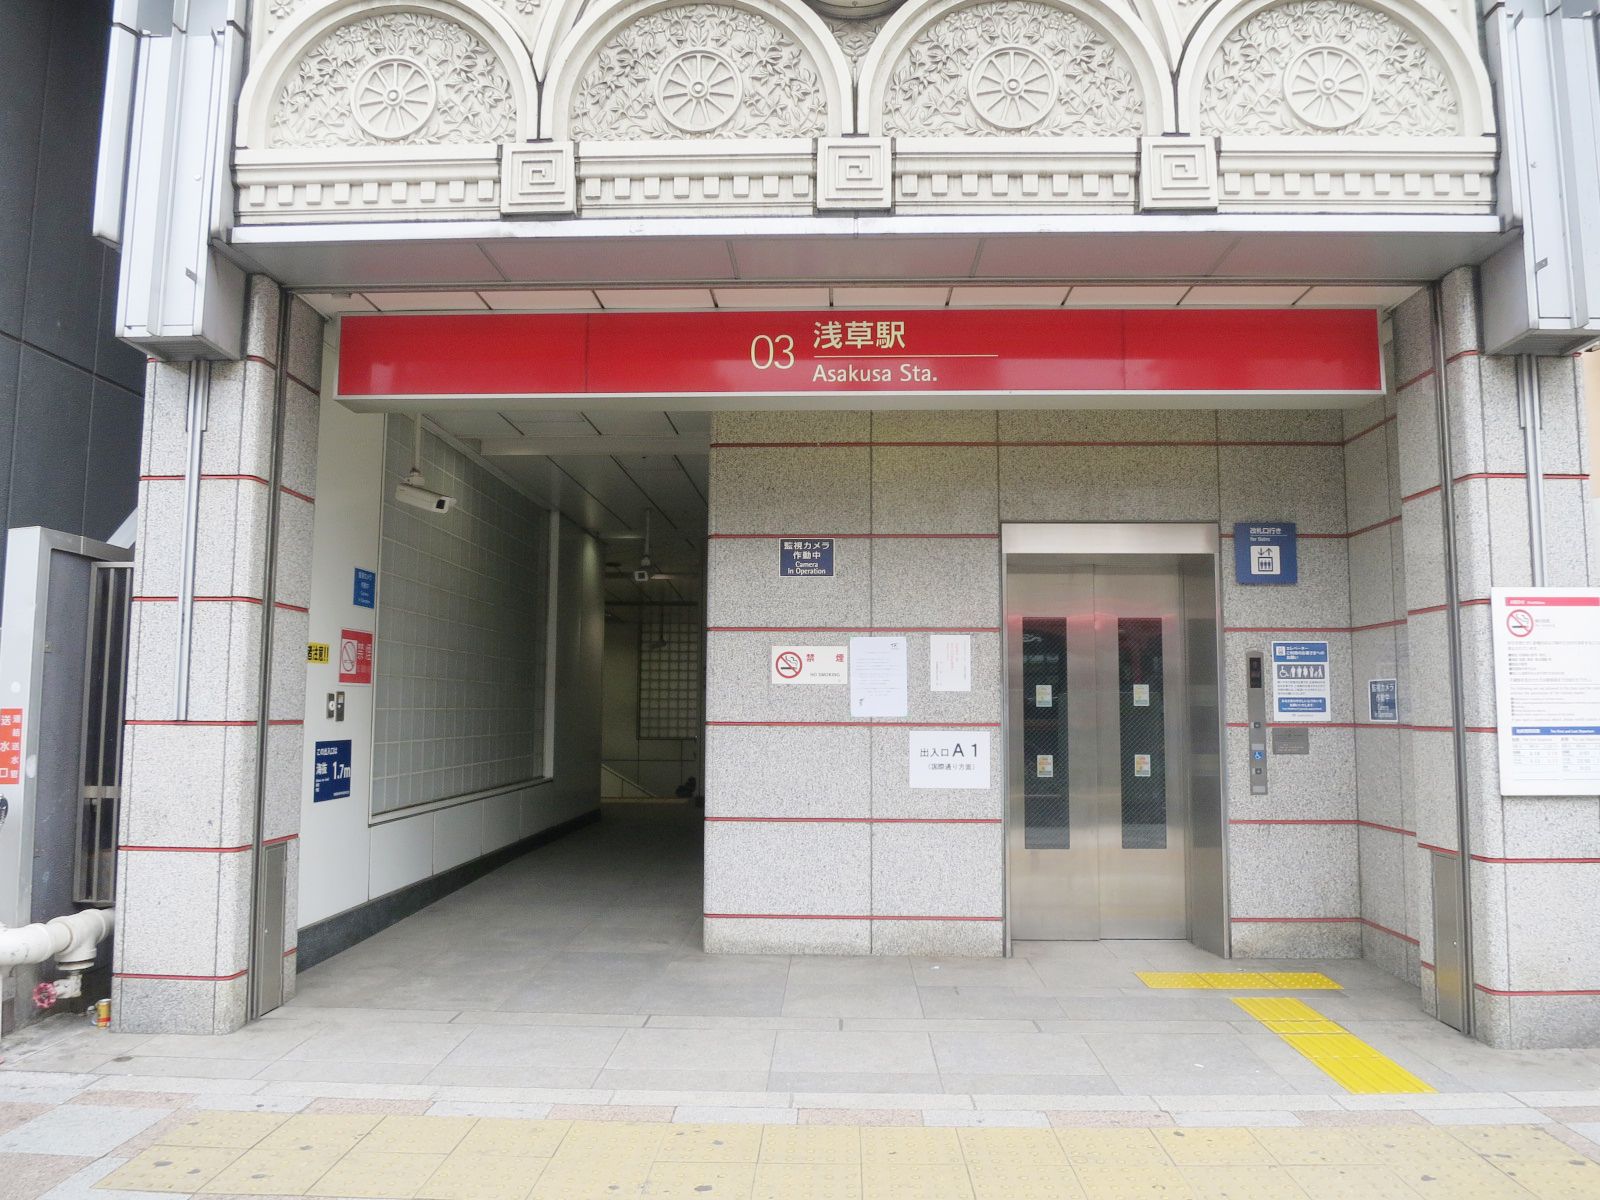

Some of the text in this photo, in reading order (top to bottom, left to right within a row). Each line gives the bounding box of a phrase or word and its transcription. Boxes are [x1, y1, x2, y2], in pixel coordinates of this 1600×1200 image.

[813, 320, 905, 349] 浅草駅
[750, 334, 794, 369] 03
[812, 364, 938, 382] Asakusa Sta.
[784, 541, 830, 550] 監視カメラ
[793, 551, 821, 560] 作動中
[795, 560, 818, 568] Camera
[795, 567, 826, 575] Operation
[920, 747, 949, 758] 出入口
[332, 761, 351, 780] 1.7m
